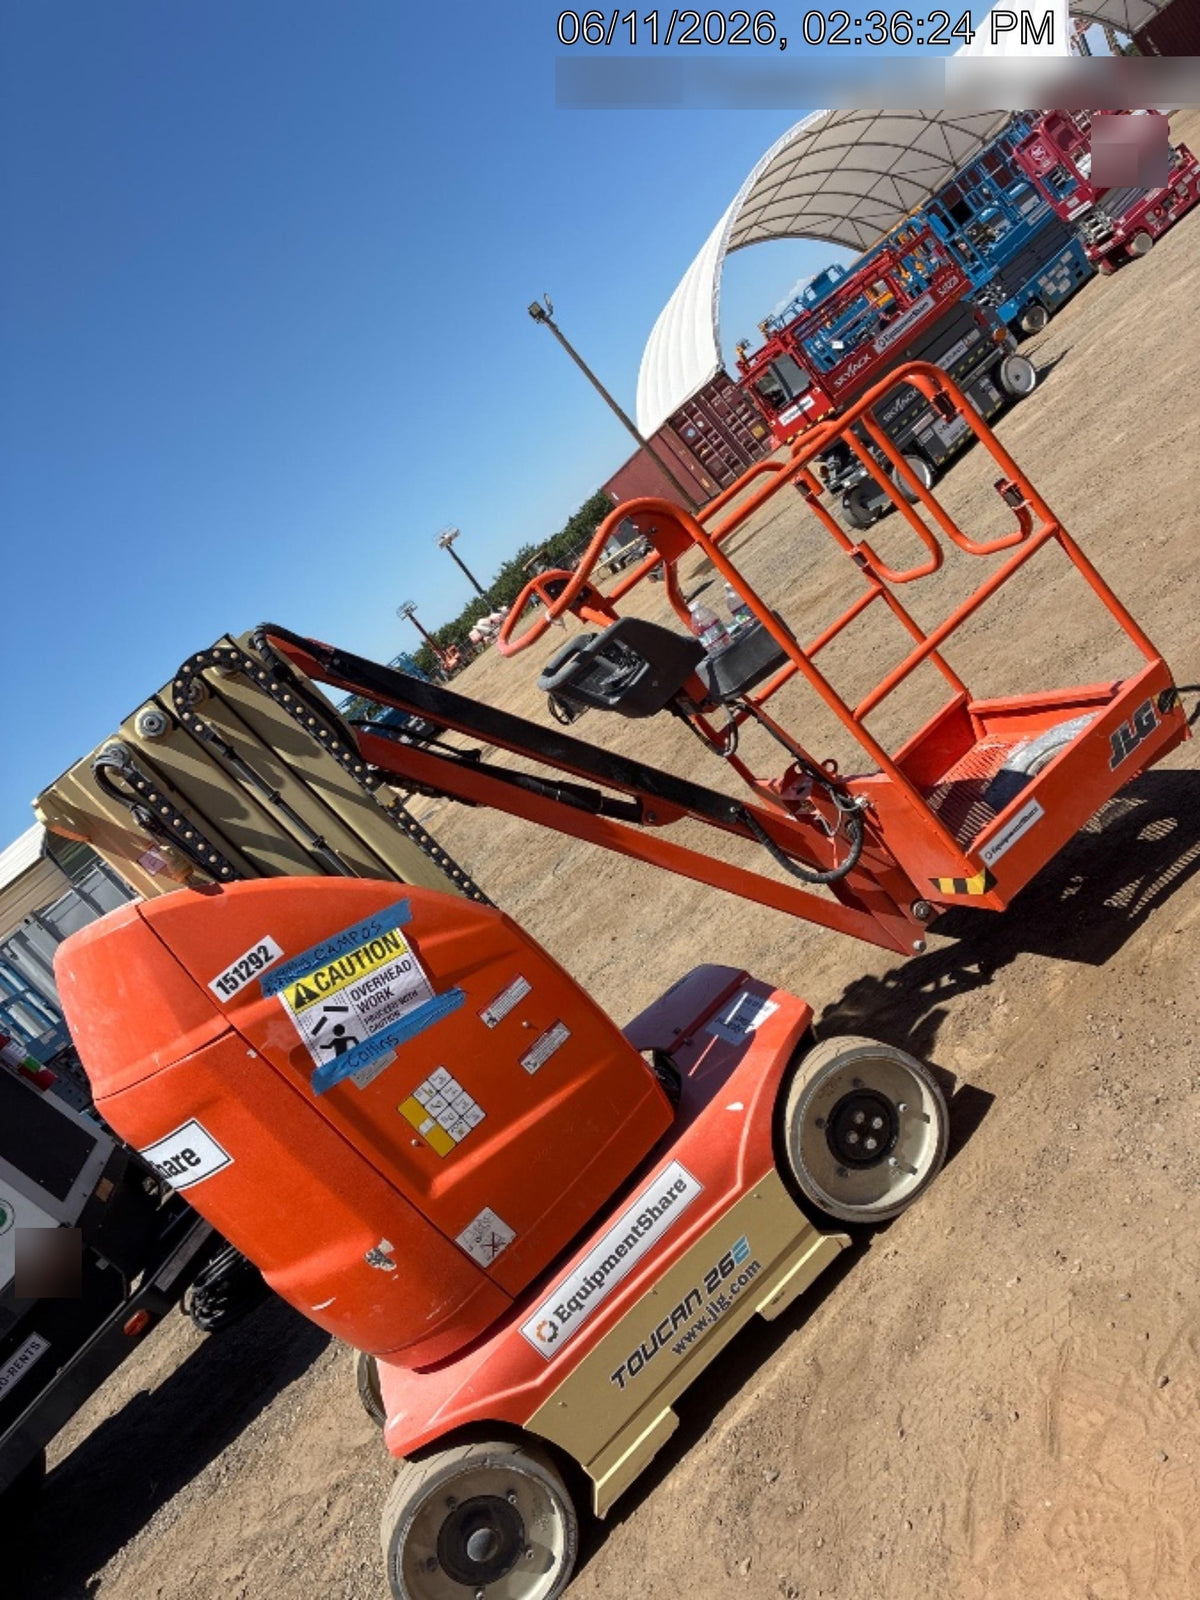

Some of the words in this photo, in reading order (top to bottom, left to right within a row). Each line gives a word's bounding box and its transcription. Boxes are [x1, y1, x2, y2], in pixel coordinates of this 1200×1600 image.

[833, 353, 872, 389] SKYJACK
[883, 387, 919, 423] SKYJACK
[1109, 698, 1161, 771] JLG
[215, 944, 274, 996] 151292
[314, 933, 401, 991] CAUTION
[350, 959, 412, 1001] OVERHEAD
[356, 987, 395, 1015] WORK
[368, 1011, 401, 1033] CAUTION
[553, 1177, 688, 1325] EquipmentShare
[610, 1287, 703, 1390] TOUCAN
[702, 1235, 752, 1294] 26E
[671, 1260, 763, 1357] www.jlg.com
[0, 1341, 42, 1391] O-RENTS
